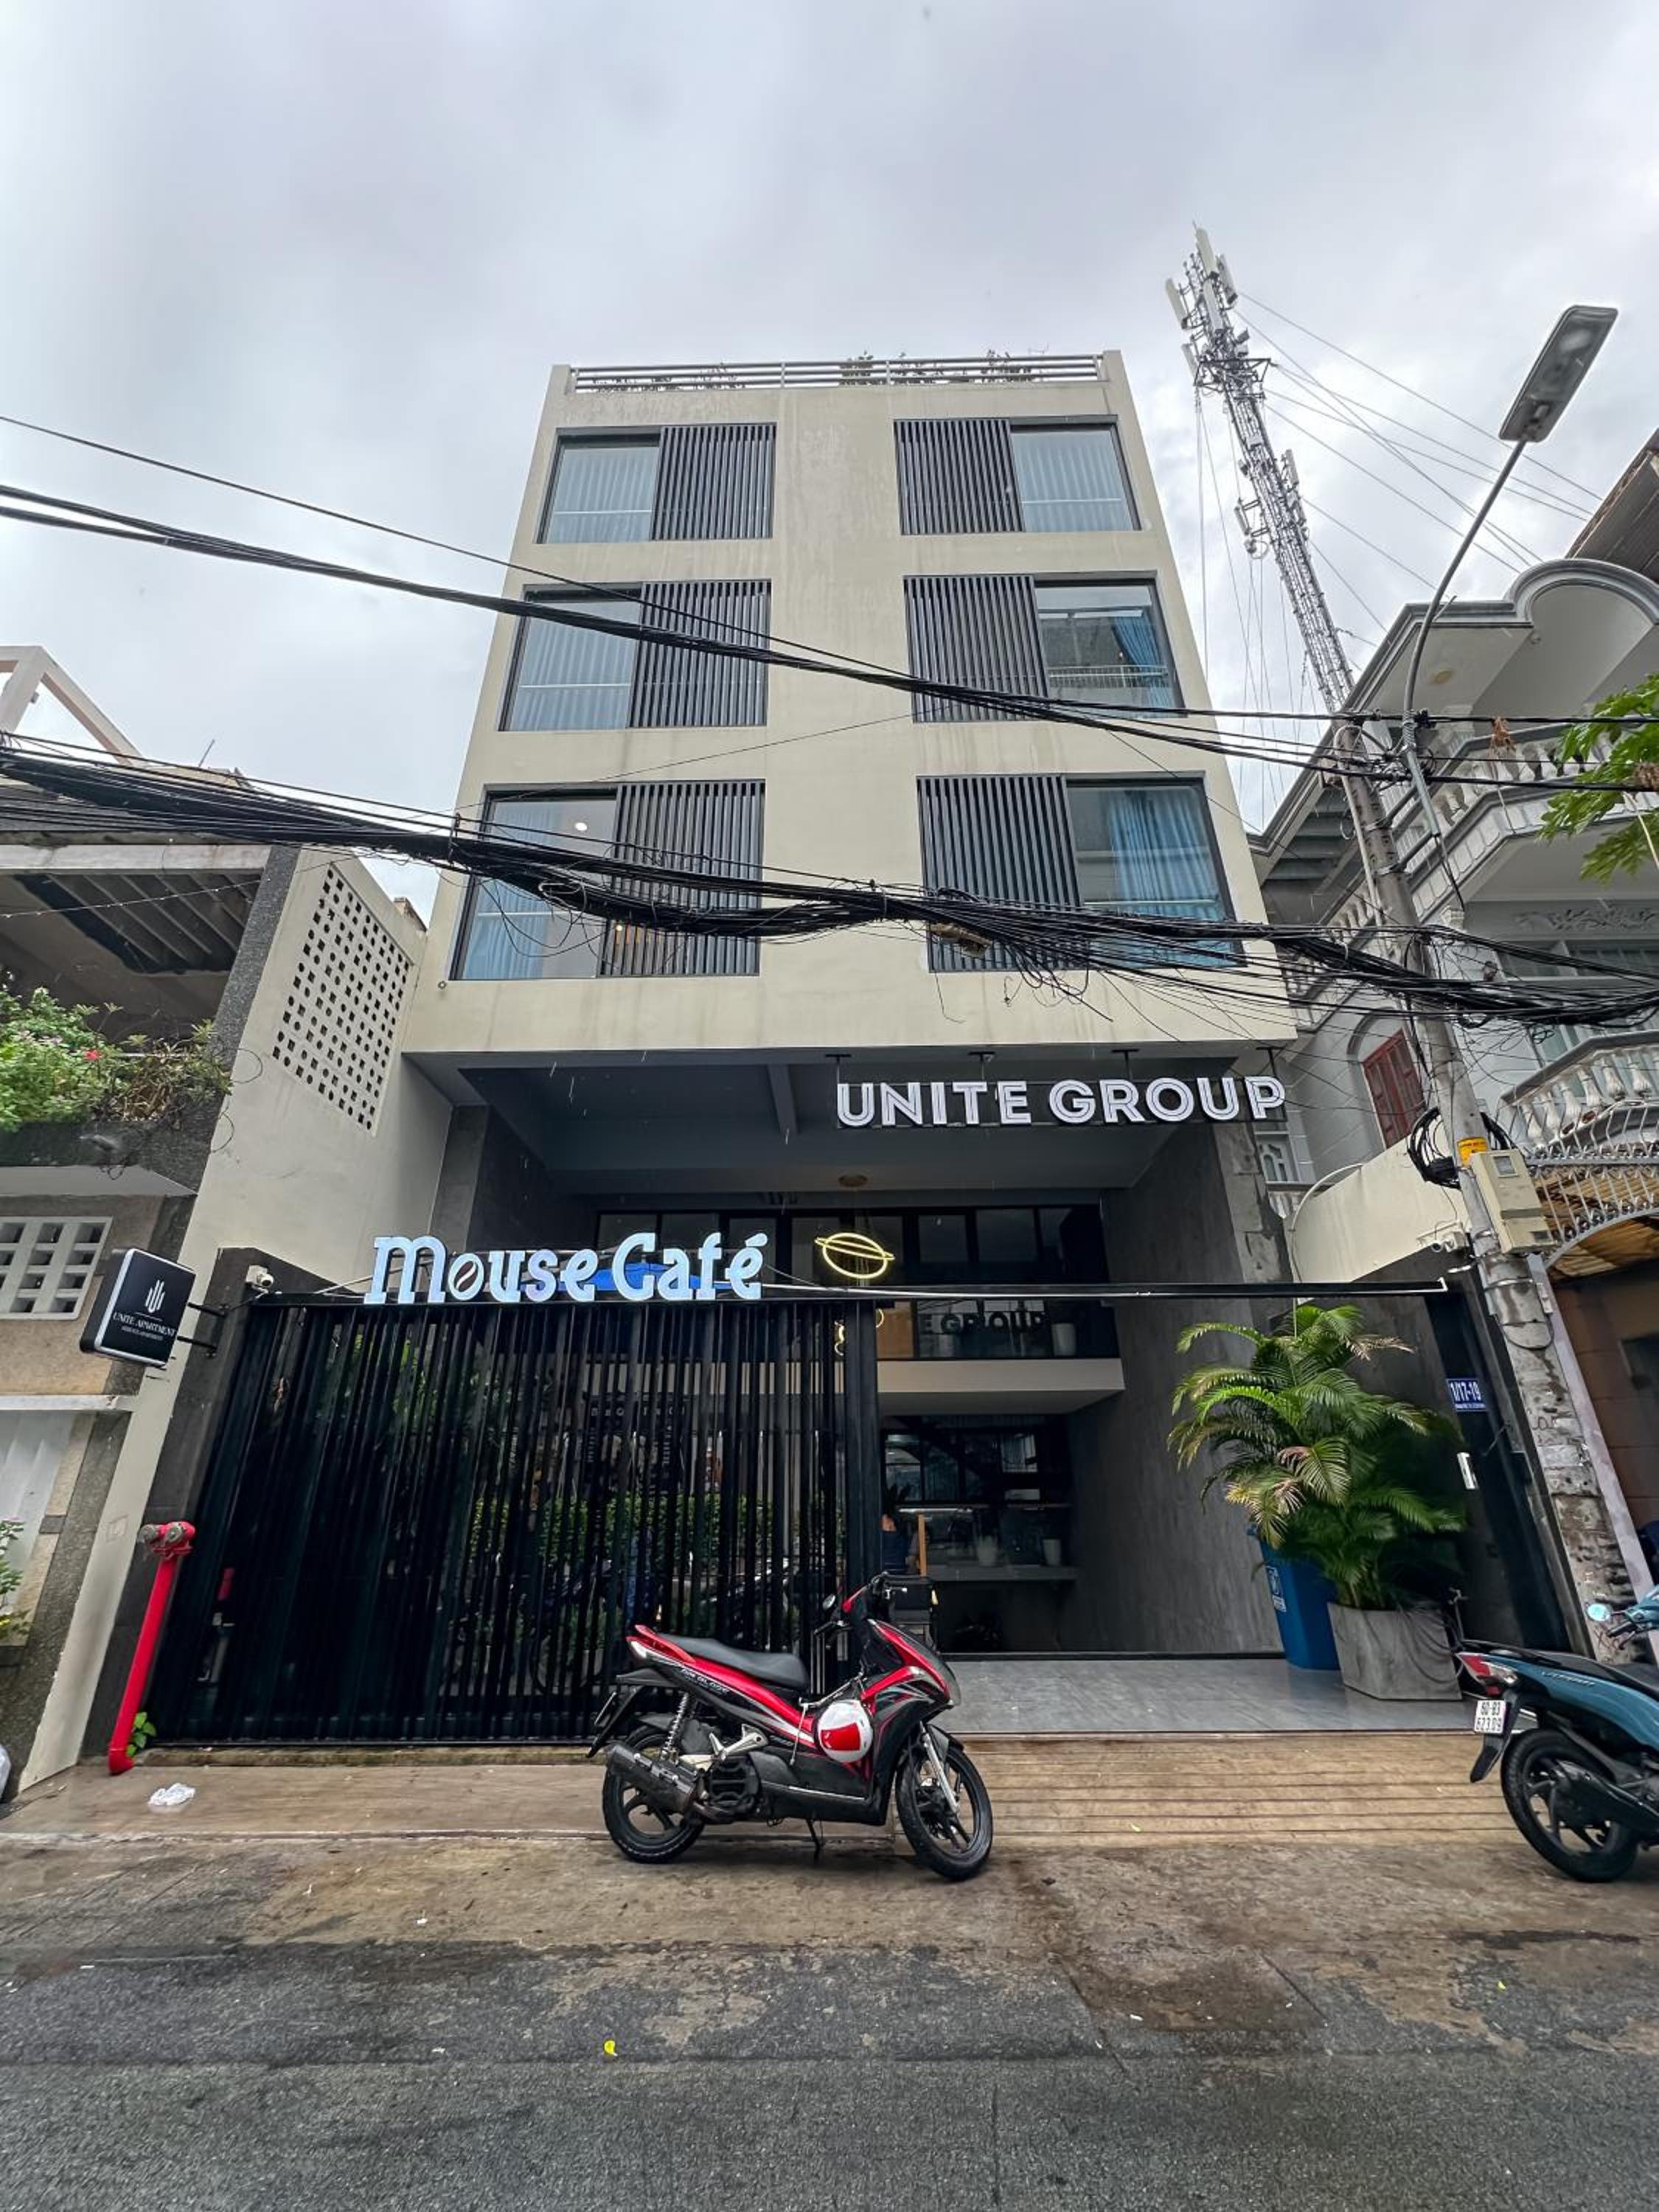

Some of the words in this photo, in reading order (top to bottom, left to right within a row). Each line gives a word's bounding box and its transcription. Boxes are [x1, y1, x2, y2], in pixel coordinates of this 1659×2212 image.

[838, 1081, 1031, 1127] UNITE
[1049, 1076, 1286, 1124] GROUP
[612, 1231, 768, 1300] Café
